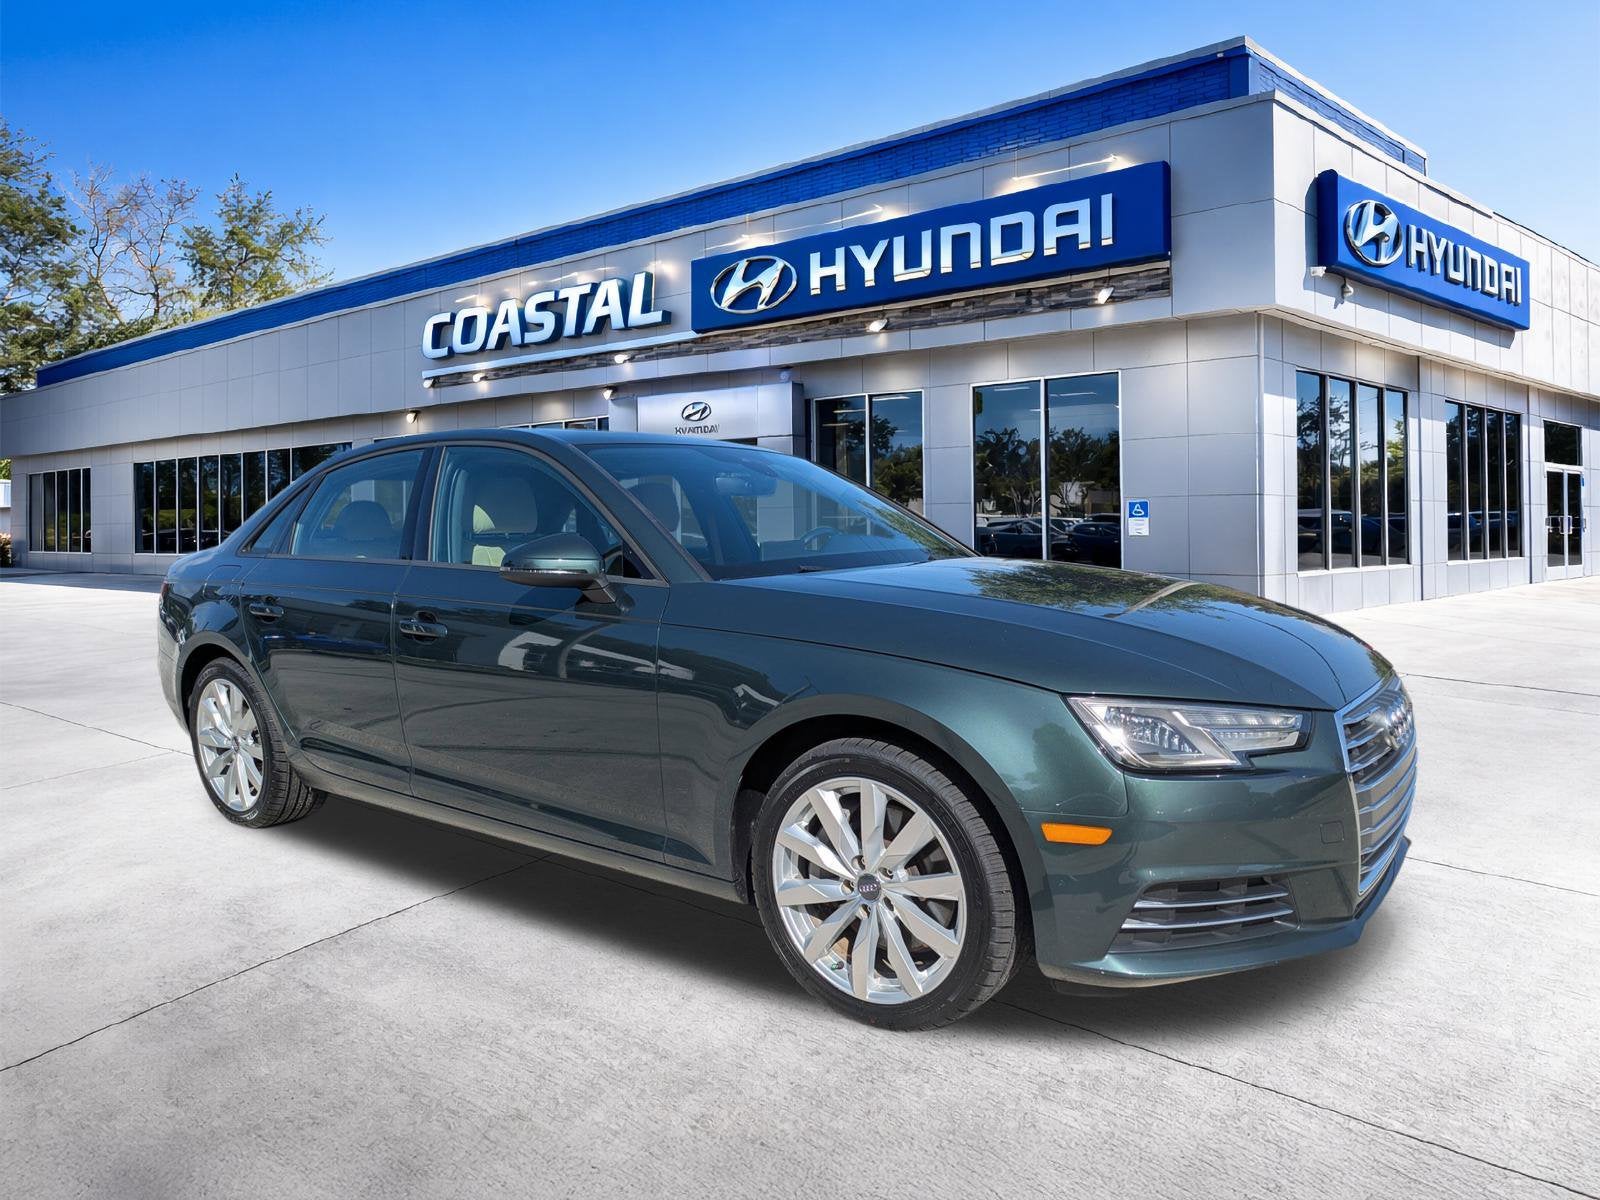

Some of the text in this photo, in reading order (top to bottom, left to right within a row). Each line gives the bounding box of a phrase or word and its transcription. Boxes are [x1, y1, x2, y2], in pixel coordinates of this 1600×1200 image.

[809, 192, 1114, 296] HYUNDAI
[1406, 224, 1522, 306] HYUNDAI
[421, 271, 671, 360] COASTAL
